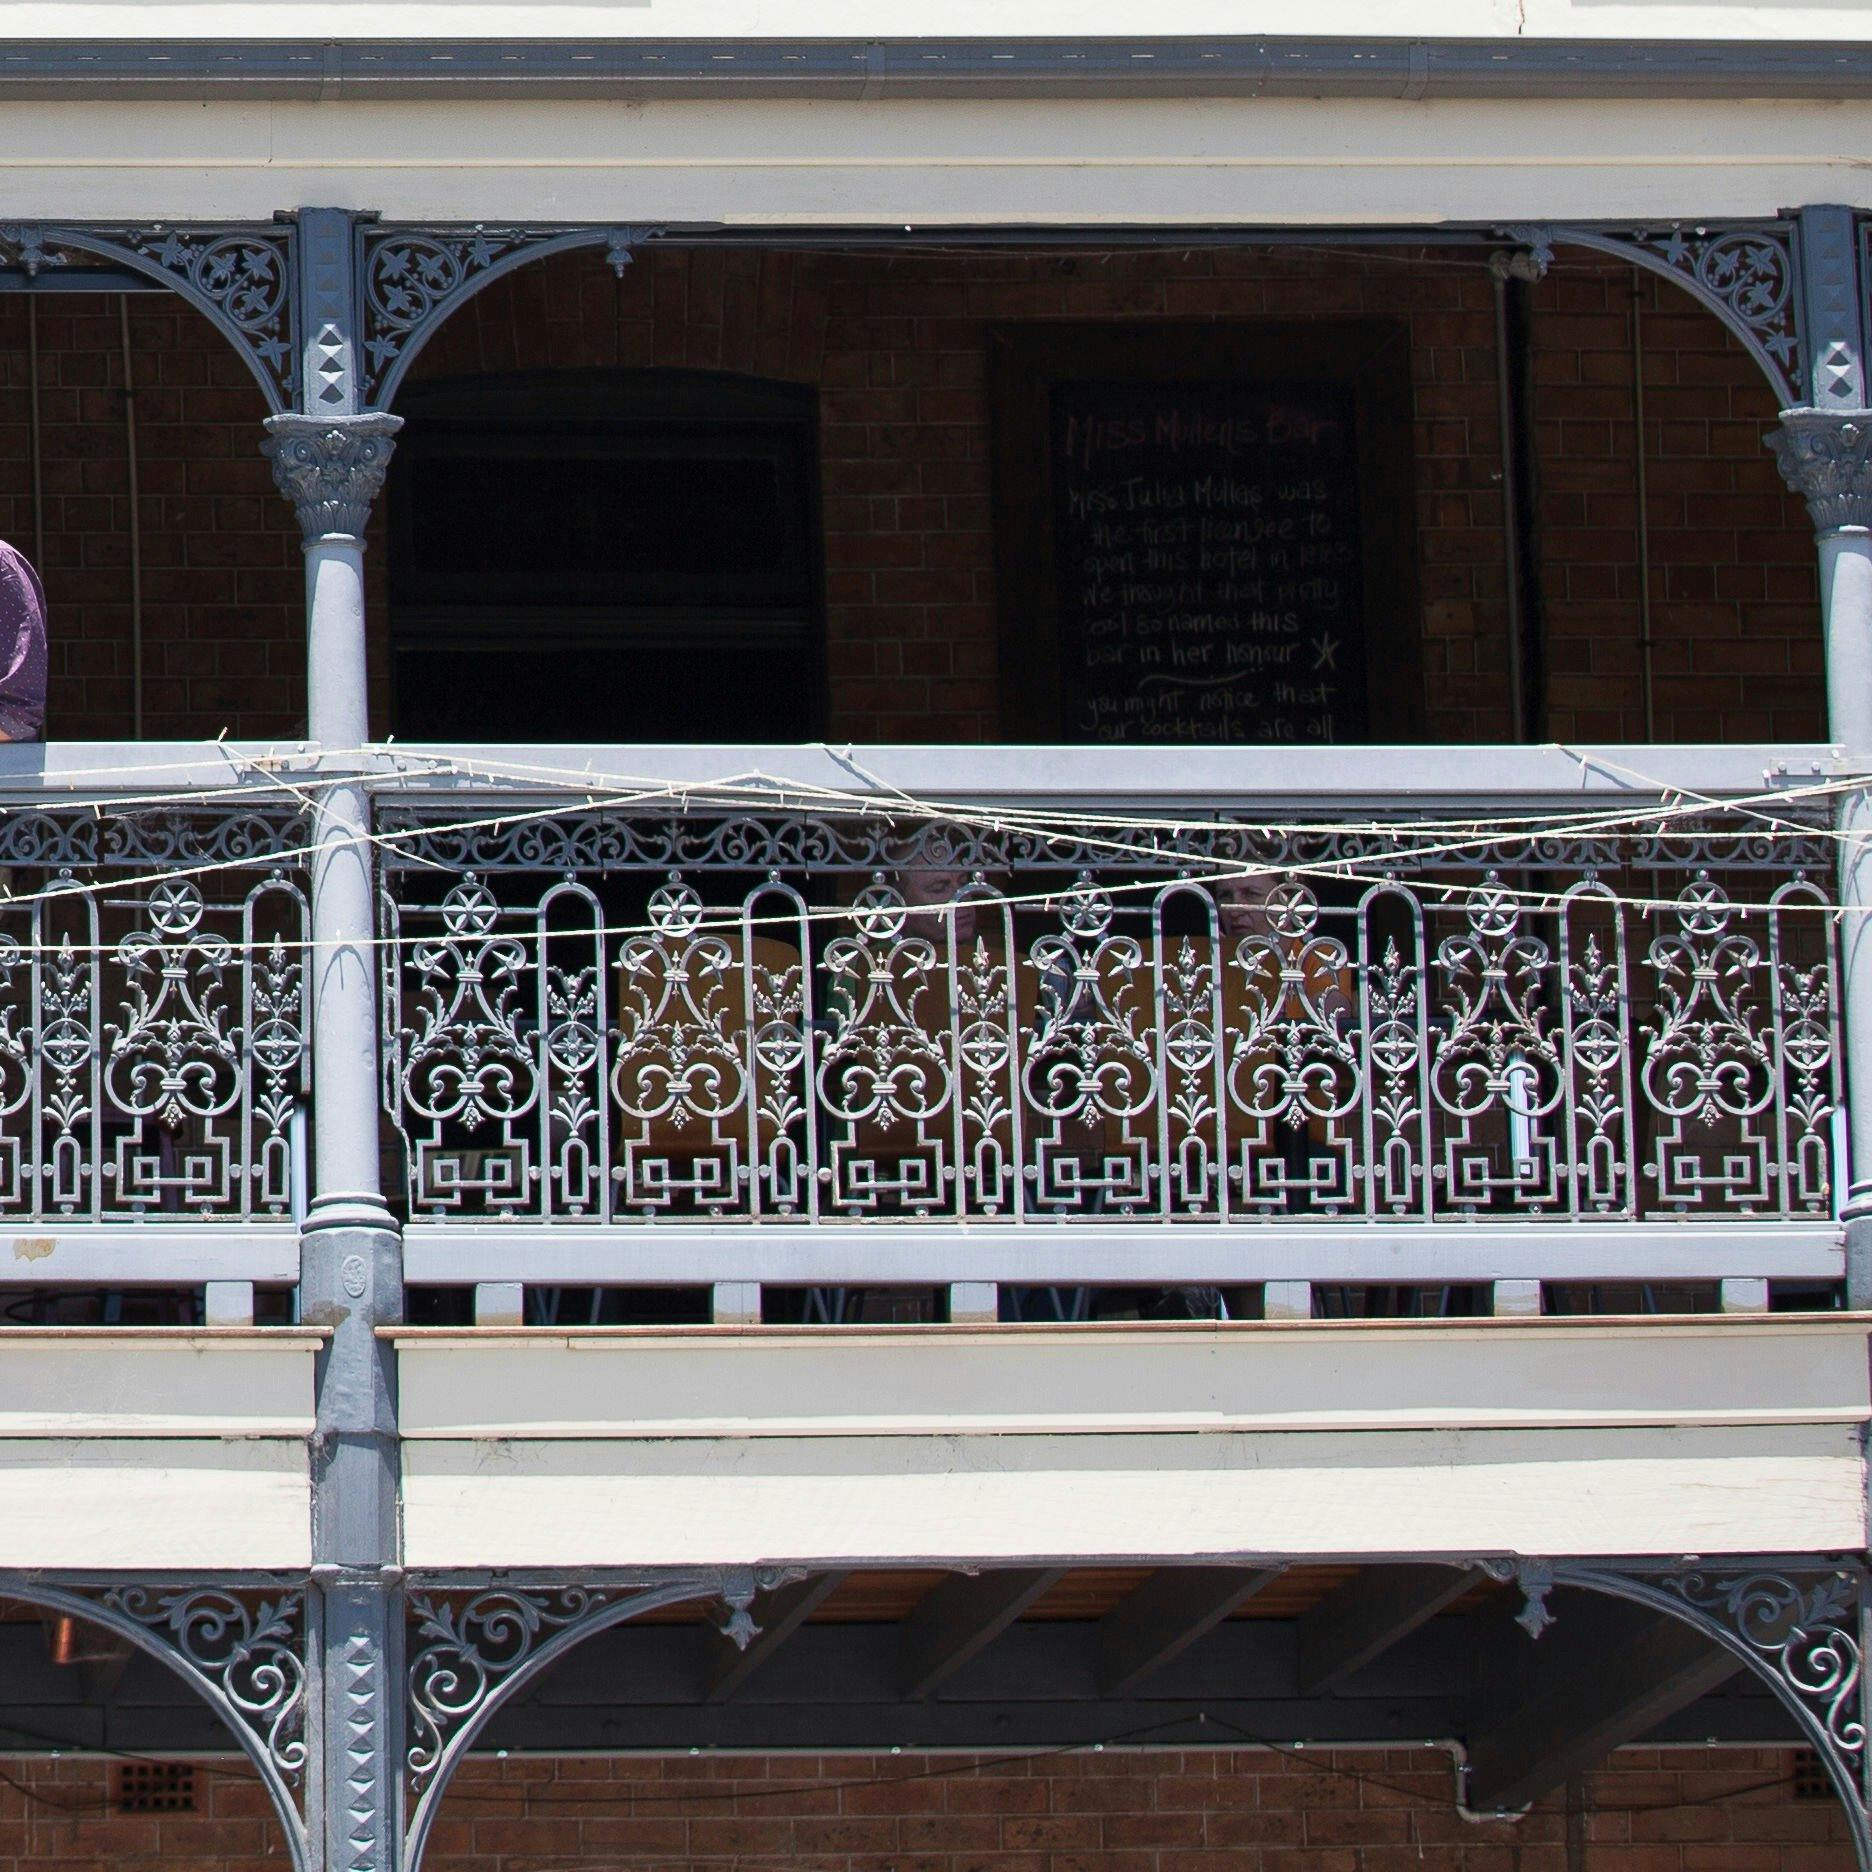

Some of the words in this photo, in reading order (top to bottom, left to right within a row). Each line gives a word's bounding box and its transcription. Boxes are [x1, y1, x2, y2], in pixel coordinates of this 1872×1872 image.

[1066, 414, 1145, 470] Miss
[1265, 403, 1345, 446] Bar
[1120, 476, 1186, 512] Julia
[1278, 480, 1329, 500] was
[1092, 524, 1132, 548] the
[1136, 519, 1195, 544] first
[1305, 514, 1332, 538] to
[1084, 552, 1135, 584] open
[1146, 547, 1187, 569] this
[1199, 546, 1257, 577] hotel
[1270, 552, 1288, 571] in
[1121, 584, 1203, 613] thought
[1216, 579, 1265, 604] that
[1137, 617, 1163, 633] so
[1167, 613, 1241, 633] named
[1252, 612, 1300, 633] this
[1086, 643, 1134, 667] bar
[1139, 646, 1161, 663] in
[1171, 640, 1214, 663] her
[1226, 640, 1301, 664] honour
[1124, 690, 1184, 722] might
[1200, 688, 1261, 712] notice
[1274, 682, 1337, 704] that
[1139, 719, 1245, 741] cocktails
[1258, 719, 1295, 738] are
[1306, 716, 1334, 744] all
